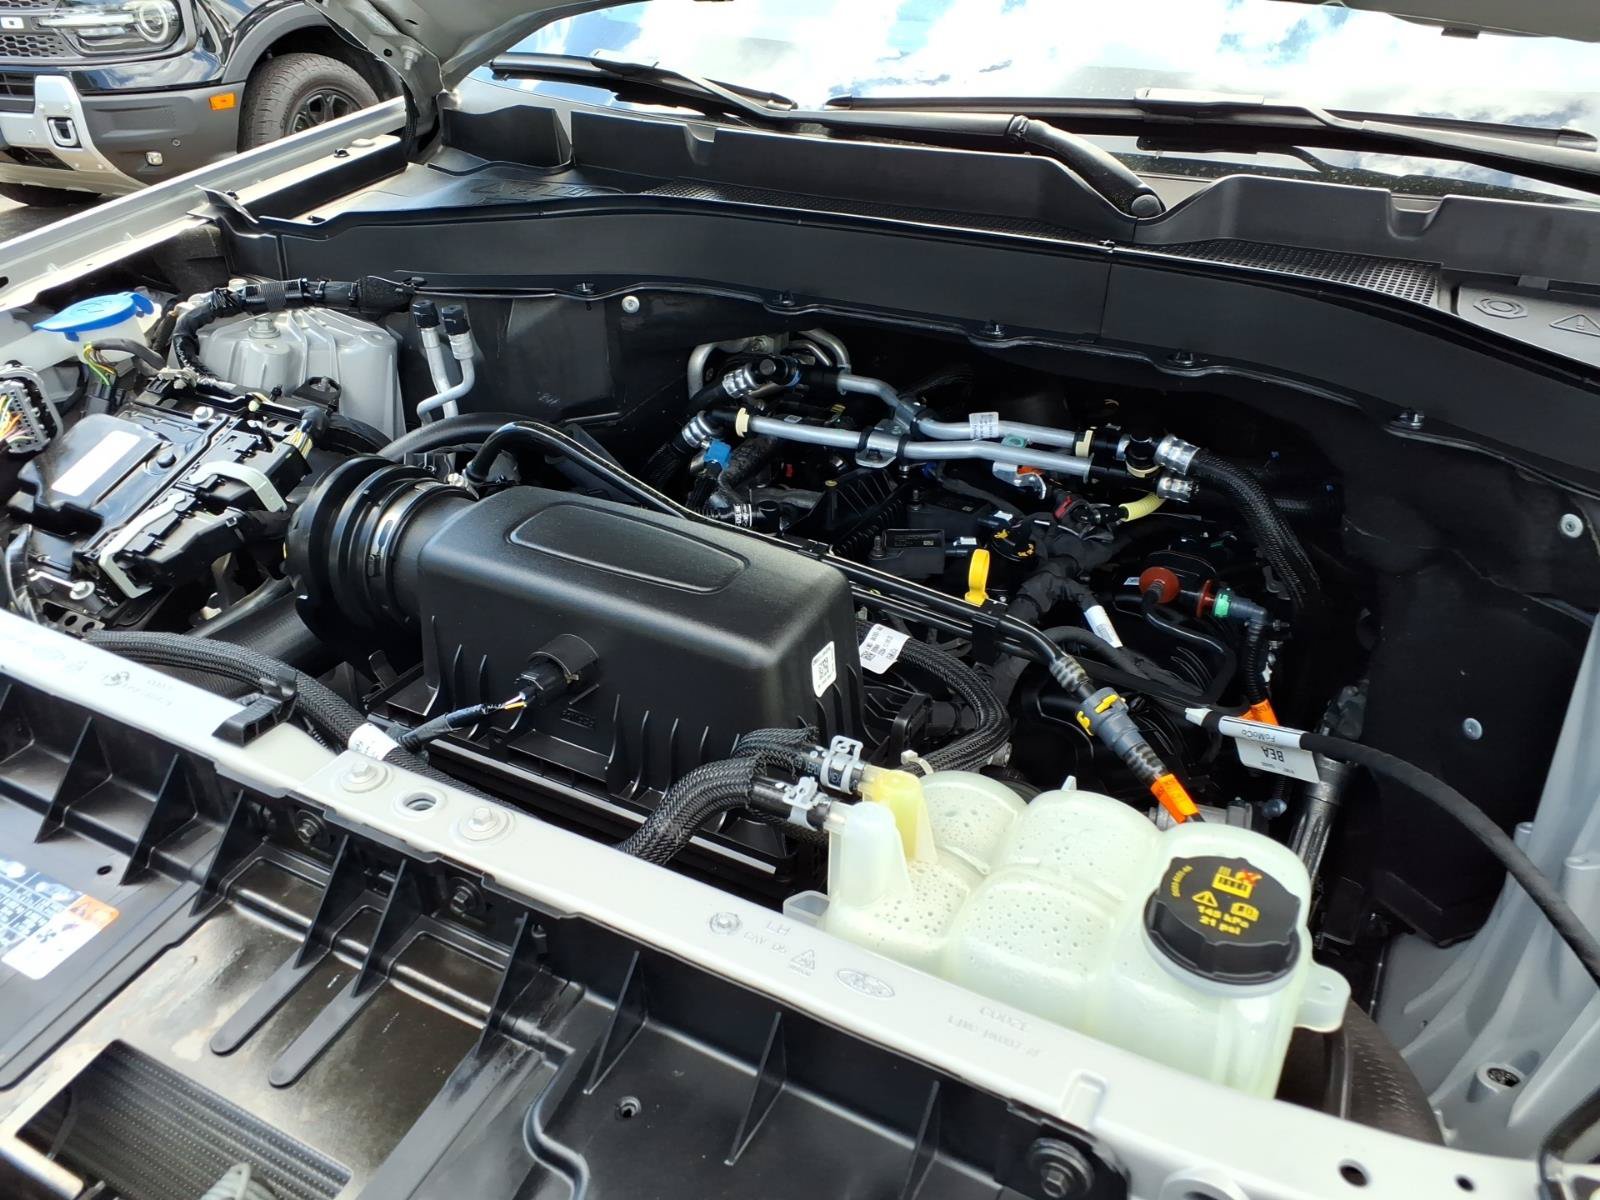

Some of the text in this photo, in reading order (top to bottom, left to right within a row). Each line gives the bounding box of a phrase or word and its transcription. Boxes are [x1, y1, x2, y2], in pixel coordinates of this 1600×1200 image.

[1241, 730, 1275, 742] FoMoCo
[1261, 746, 1285, 762] BEA
[1199, 916, 1241, 935] 21 psi
[1223, 913, 1249, 928] kPa
